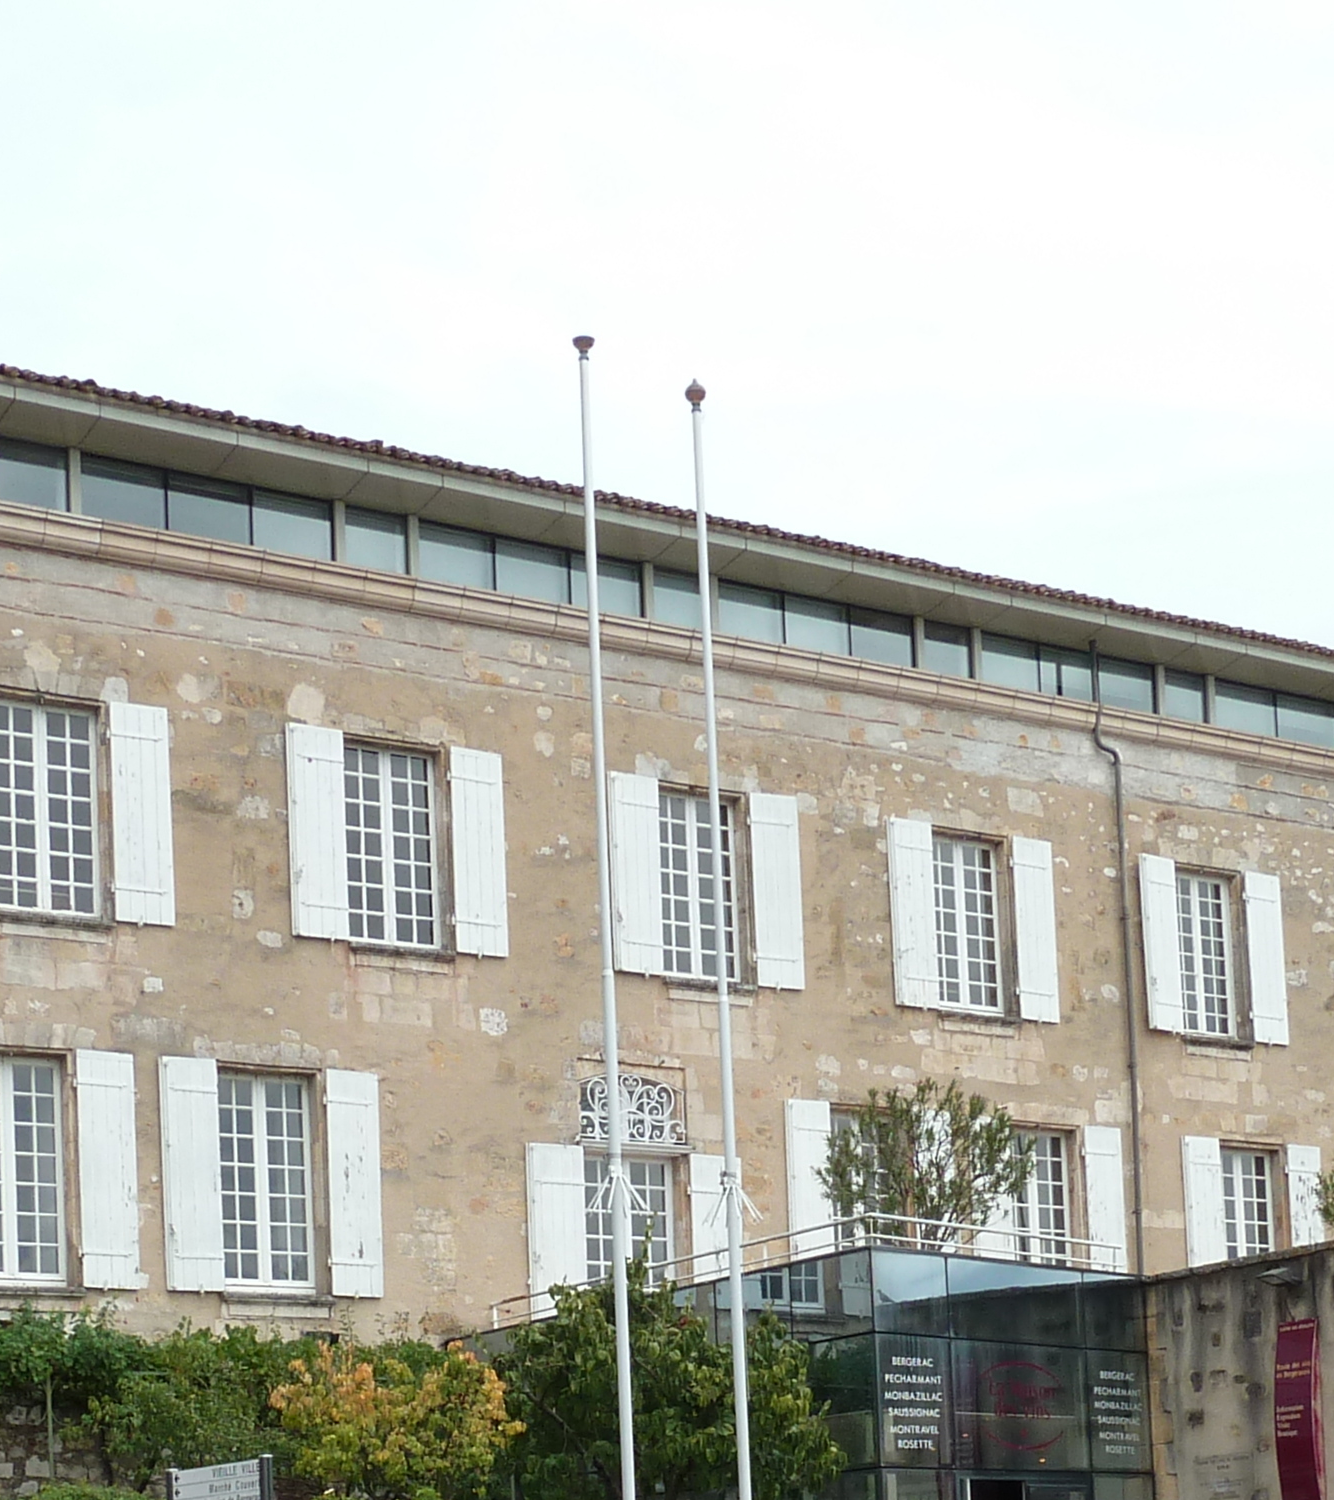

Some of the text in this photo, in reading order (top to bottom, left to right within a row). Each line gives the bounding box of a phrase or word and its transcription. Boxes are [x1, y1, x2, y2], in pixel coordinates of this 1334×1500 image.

[891, 1356, 934, 1367] BERGERAC
[884, 1373, 942, 1385] PECHARMANT
[1099, 1370, 1135, 1381] BERGERAC
[884, 1391, 943, 1402] MONBAZILLAC
[1093, 1386, 1142, 1397] PECHARMANT
[1094, 1400, 1143, 1412] MONBAZILLAC
[888, 1407, 941, 1418] SAUSSIGNAC
[1097, 1415, 1141, 1426] SAUSSIGNAC
[890, 1425, 940, 1435] MONTRAVEL
[1099, 1431, 1140, 1441] MONTRAVEL
[897, 1439, 933, 1449] ROSETTE
[1105, 1445, 1135, 1455] ROSETTE
[235, 1479, 258, 1491] Couver
